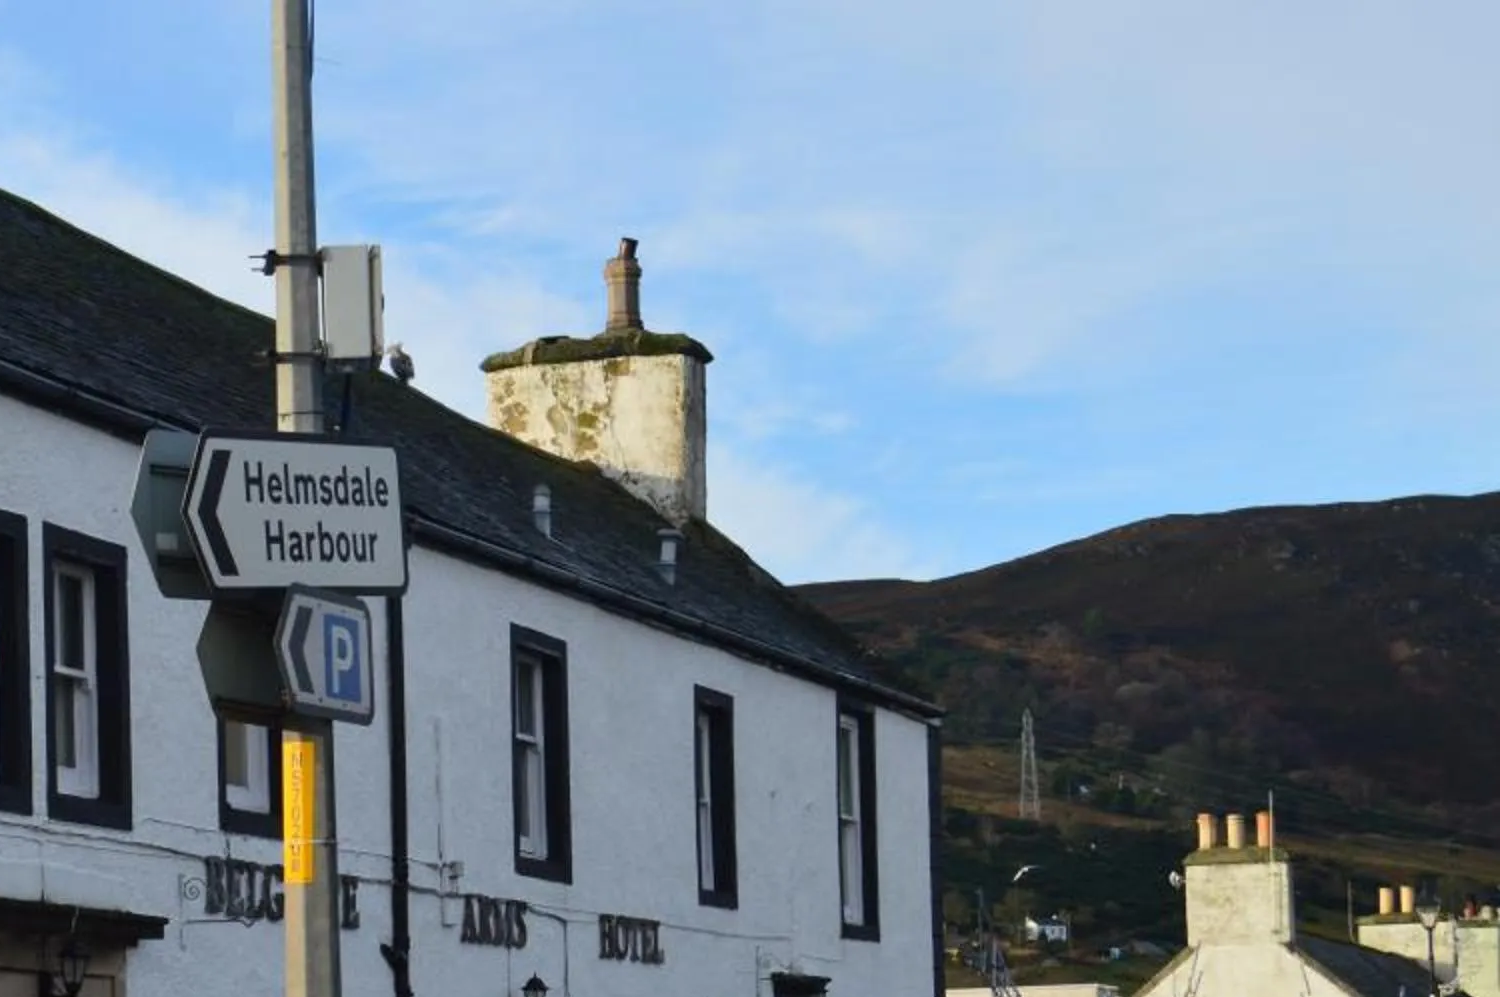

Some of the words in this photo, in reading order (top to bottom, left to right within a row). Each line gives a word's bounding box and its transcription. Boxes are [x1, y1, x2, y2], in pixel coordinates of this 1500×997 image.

[243, 460, 390, 507] Helmsdale
[264, 520, 378, 563] Harbour
[331, 624, 354, 694] P
[460, 893, 527, 950] ARMS
[598, 912, 665, 965] HOTEL
